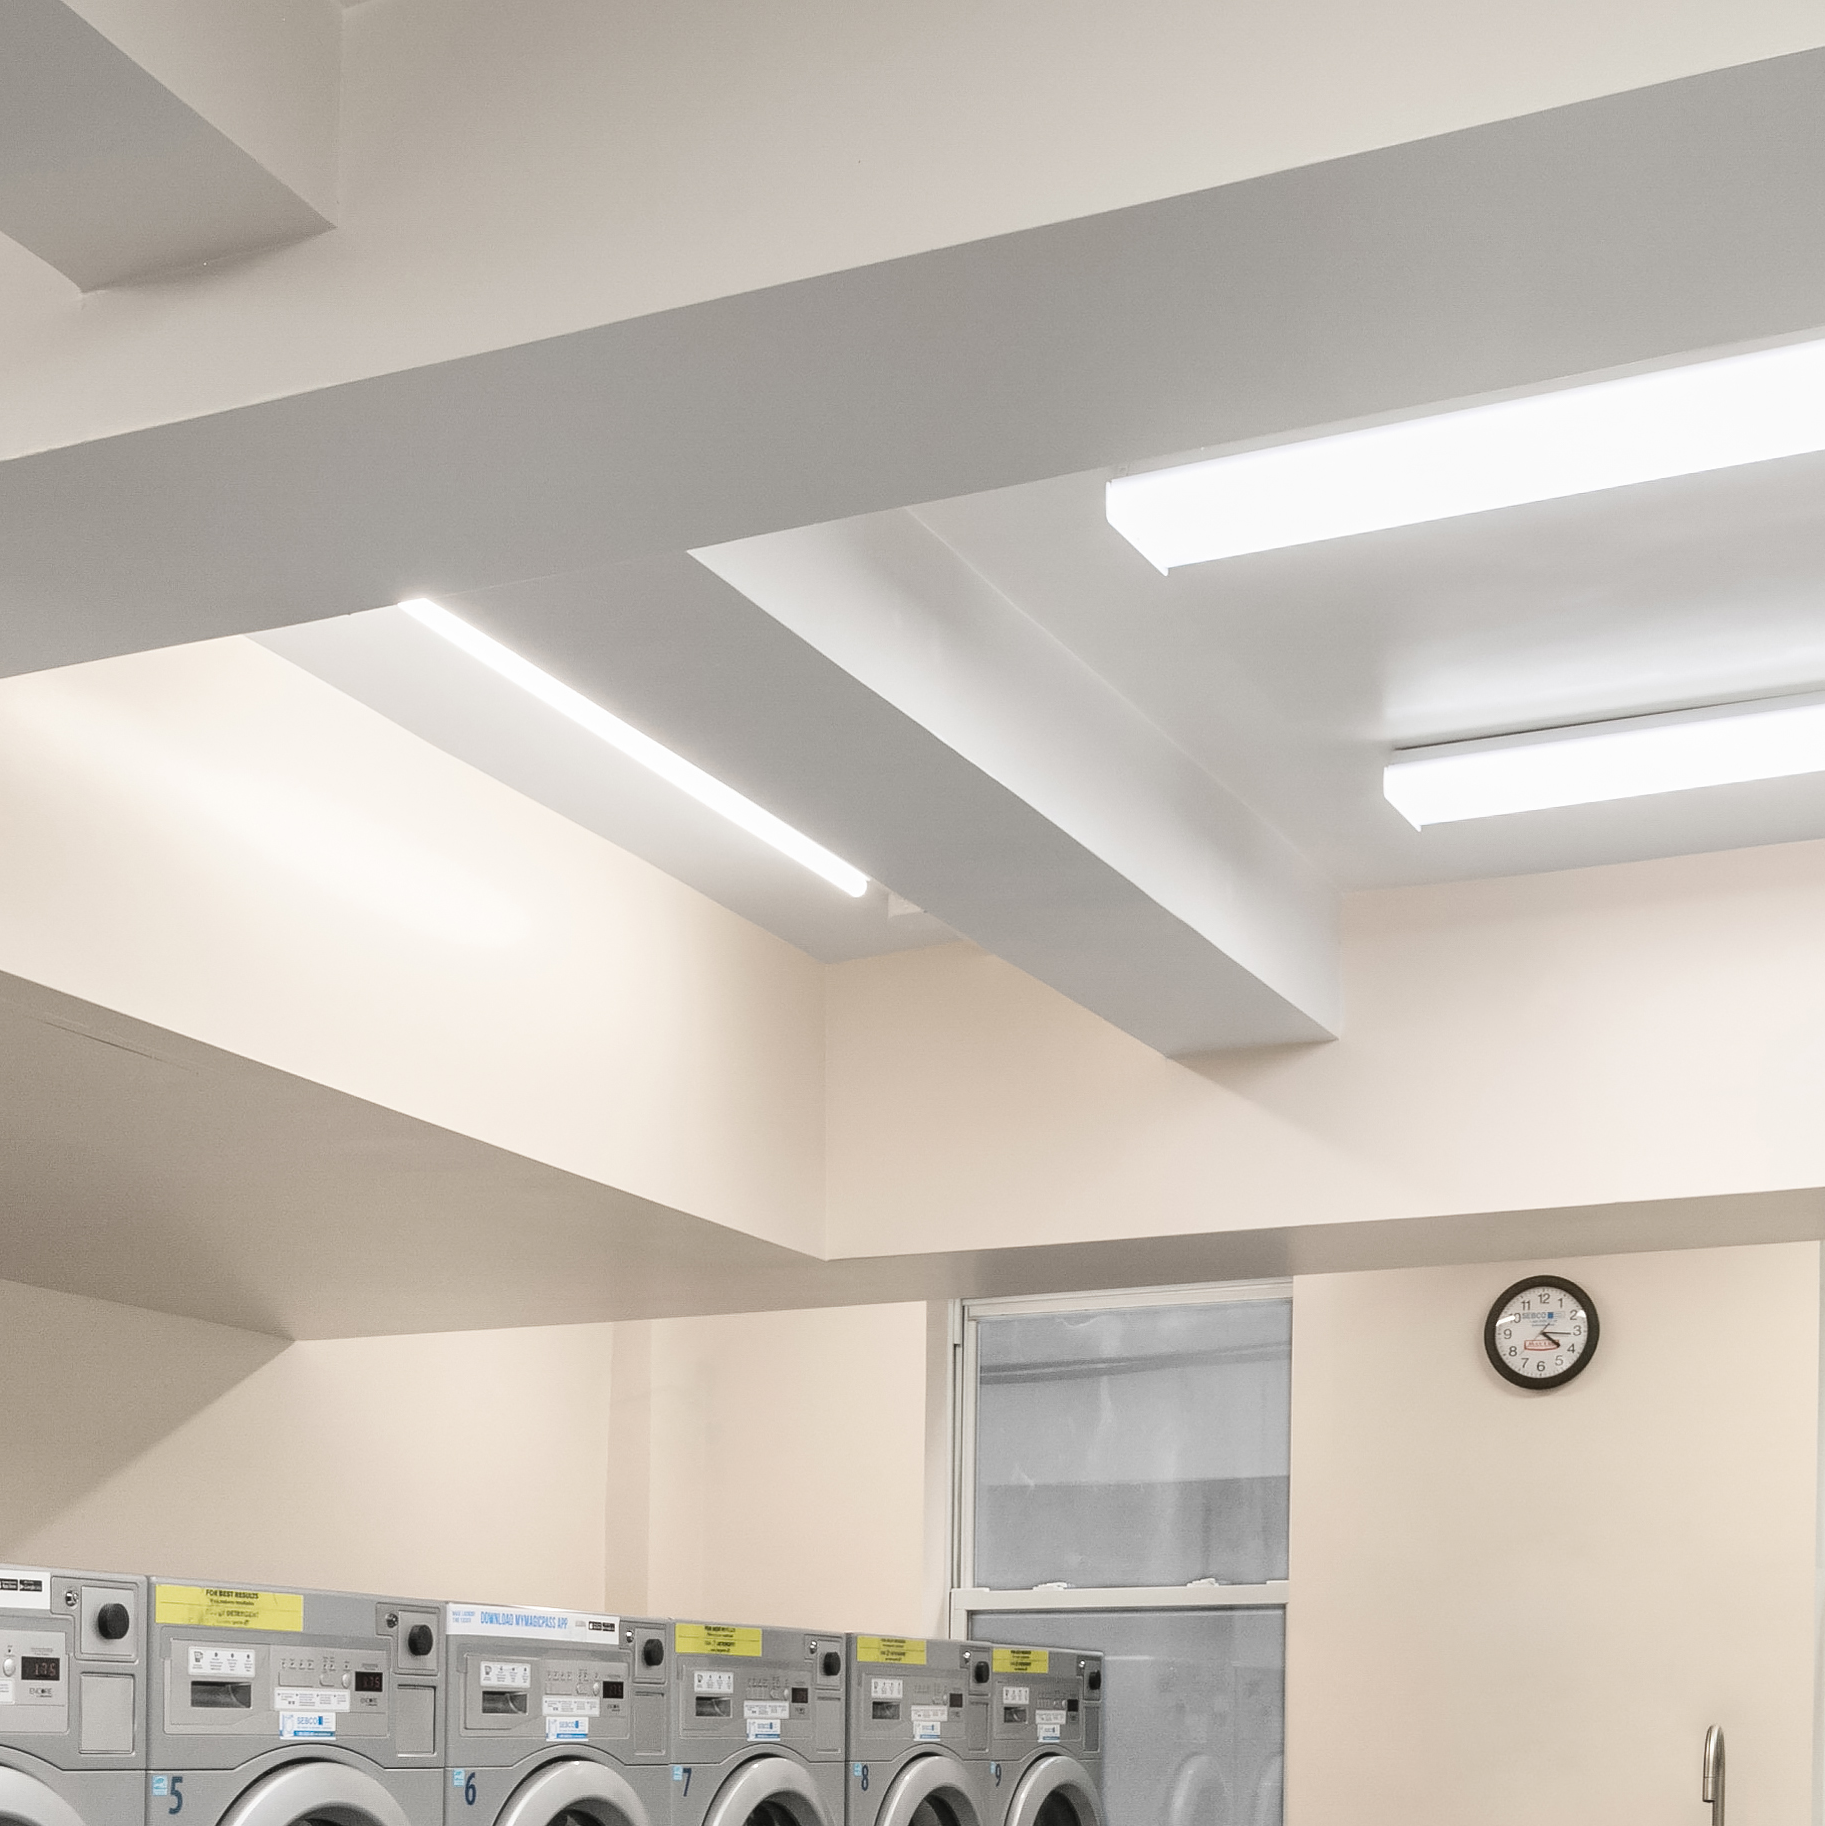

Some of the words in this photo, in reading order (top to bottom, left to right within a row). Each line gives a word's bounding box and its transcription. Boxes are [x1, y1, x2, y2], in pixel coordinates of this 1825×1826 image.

[1538, 1293, 1550, 1304] 12
[1558, 1298, 1564, 1308] 1
[1521, 1300, 1531, 1310] 11
[1570, 1310, 1578, 1320] 2
[1504, 1329, 1512, 1340] 9
[1573, 1325, 1582, 1336] 3
[1508, 1346, 1517, 1356] 8
[1567, 1344, 1575, 1353] 4
[1521, 1358, 1529, 1368] 7
[1536, 1361, 1545, 1371] 6
[1555, 1355, 1564, 1366] 5
[480, 1611, 513, 1625] DOWNLOAD
[515, 1614, 556, 1628] MYMAGICPASS
[557, 1618, 568, 1629] APP
[861, 1764, 869, 1791] 8
[995, 1764, 1002, 1787] 9
[682, 1768, 692, 1797] 7
[465, 1773, 476, 1806] 6
[168, 1777, 184, 1815] 5
